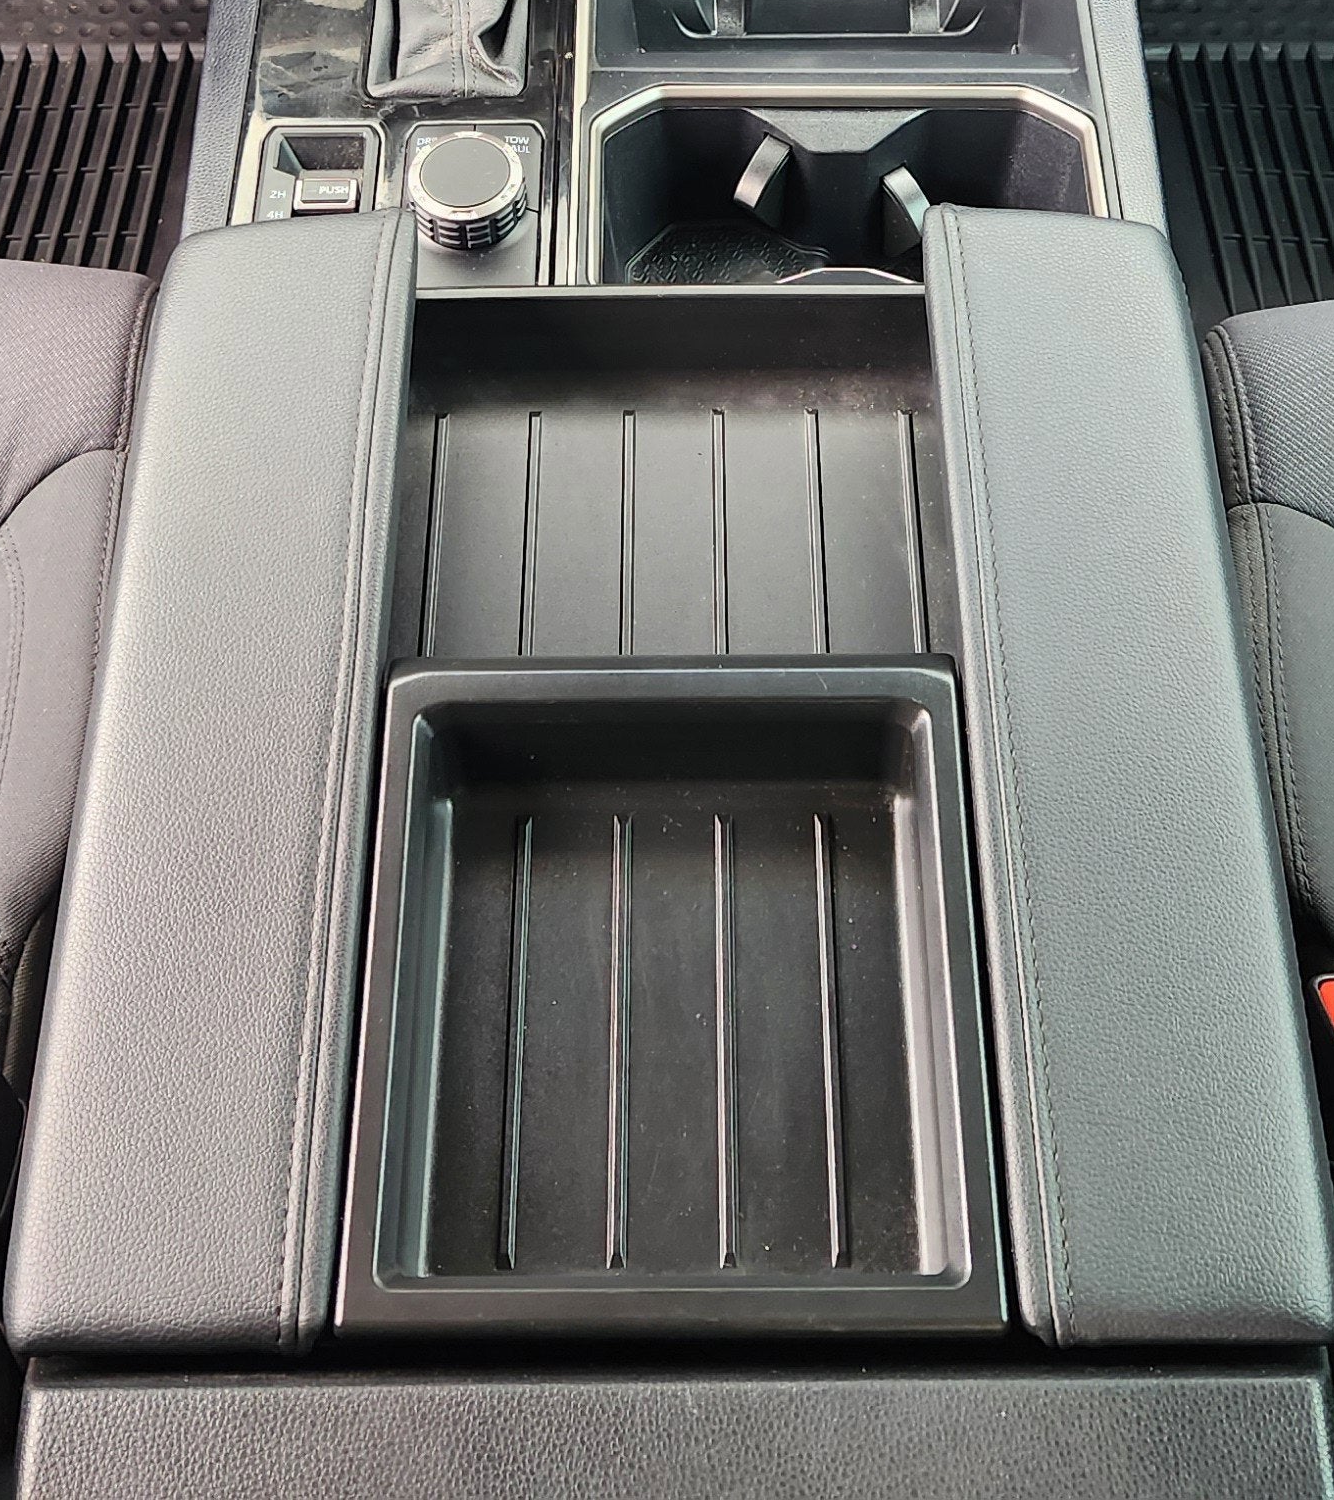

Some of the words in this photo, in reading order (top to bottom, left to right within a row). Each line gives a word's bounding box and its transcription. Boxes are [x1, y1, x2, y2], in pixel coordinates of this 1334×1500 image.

[504, 136, 530, 145] TOW
[269, 189, 287, 199] 2H
[318, 184, 349, 195] PUSH
[266, 210, 284, 219] 4H
